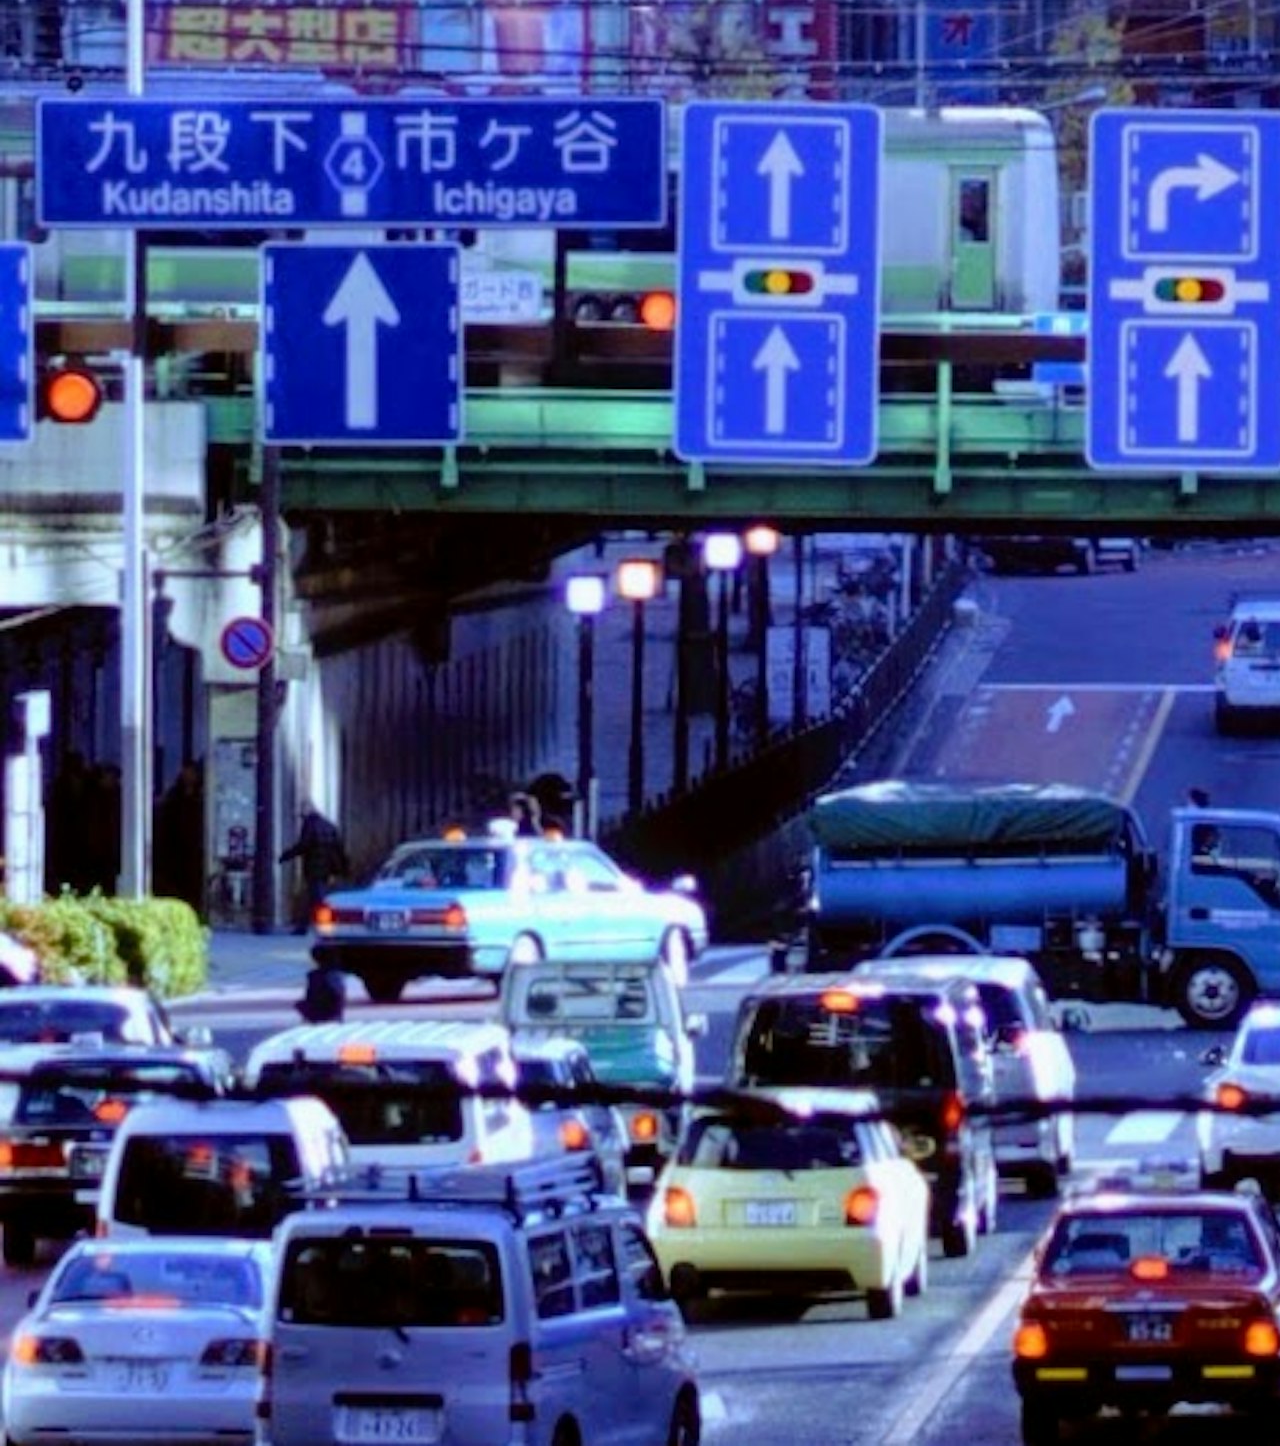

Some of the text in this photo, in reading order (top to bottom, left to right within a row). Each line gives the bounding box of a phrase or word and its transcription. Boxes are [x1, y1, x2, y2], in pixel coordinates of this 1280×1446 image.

[86, 111, 312, 176] 九段下
[341, 151, 366, 178] 4
[102, 182, 294, 216] Kudanshita
[434, 183, 578, 223] Ichigaya
